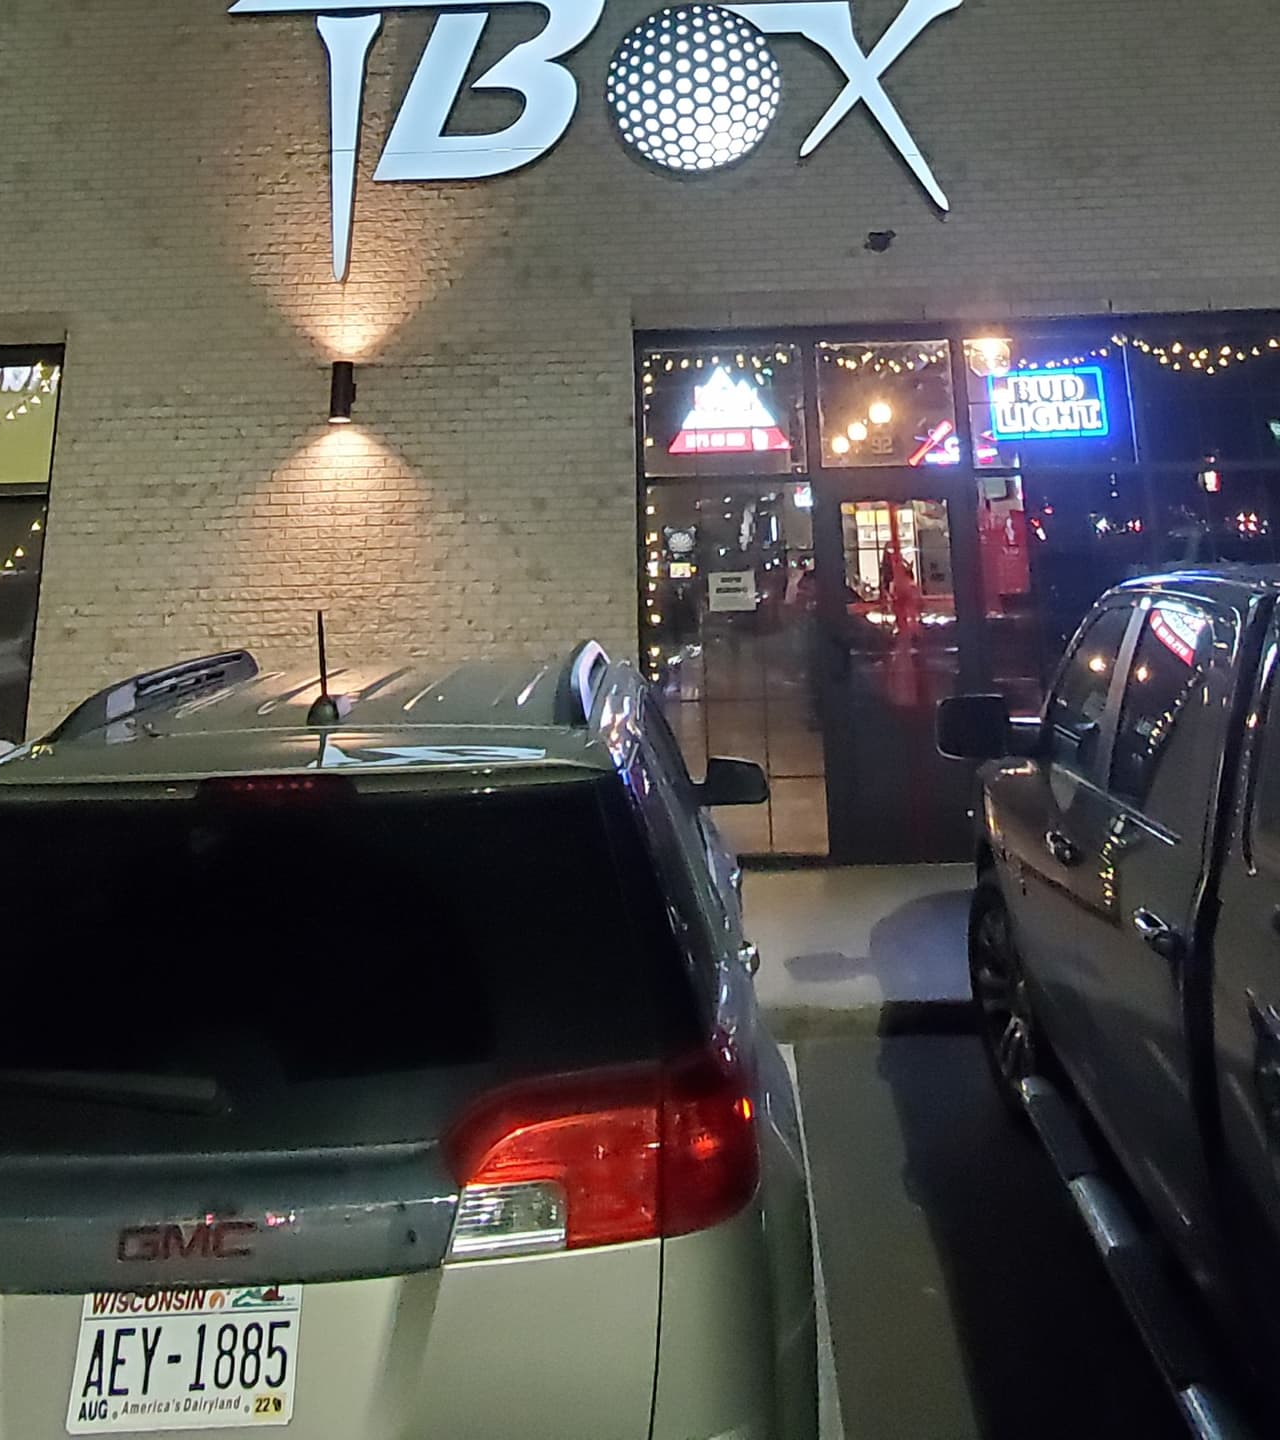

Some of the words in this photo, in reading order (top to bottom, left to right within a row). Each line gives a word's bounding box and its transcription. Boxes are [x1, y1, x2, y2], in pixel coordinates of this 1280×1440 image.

[1006, 375, 1084, 404] BUD
[997, 401, 1102, 432] LIGHT
[118, 1221, 257, 1261] GMC
[93, 1288, 206, 1314] WISCONSIN
[82, 1320, 291, 1398] AEY-1885
[78, 1399, 108, 1421] AUG
[122, 1400, 180, 1415] America's
[184, 1396, 241, 1414] Dairyland
